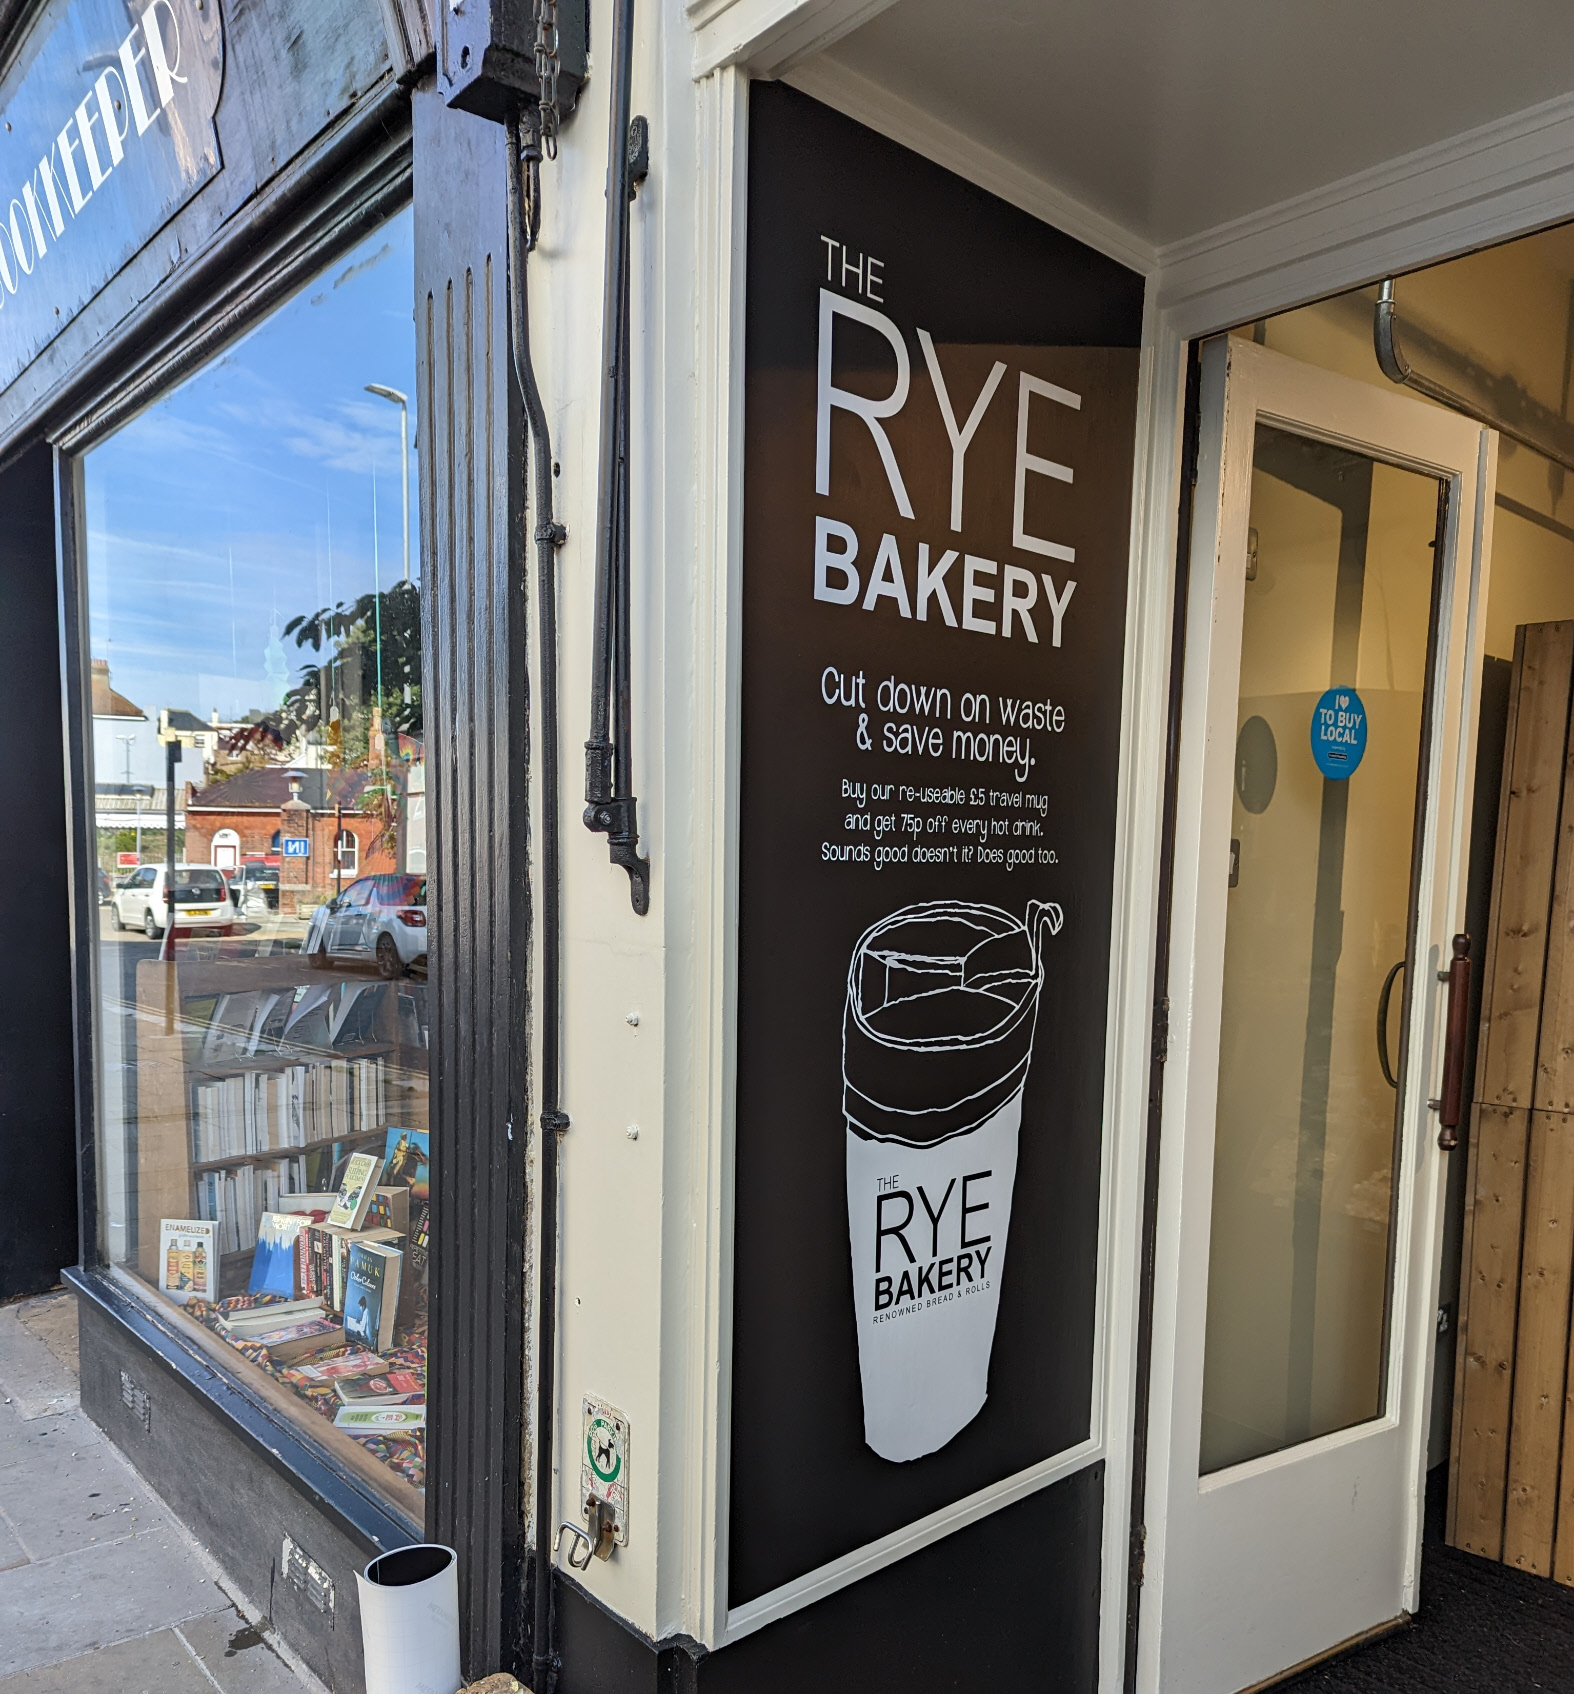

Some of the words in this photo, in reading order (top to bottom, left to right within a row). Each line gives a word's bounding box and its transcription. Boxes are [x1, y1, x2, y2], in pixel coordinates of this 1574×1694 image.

[0, 0, 188, 309] OOKKEEPER
[820, 234, 885, 304] THE
[815, 287, 1082, 564] RYE
[813, 515, 1078, 649] BAKERY
[821, 666, 866, 709] Cut
[877, 675, 951, 720] down
[960, 692, 990, 724] on
[998, 697, 1066, 733] waste
[1319, 708, 1335, 725] TO
[1337, 711, 1363, 729] BUY
[1335, 694, 1340, 710] I
[856, 713, 872, 750] &
[882, 722, 944, 757] save
[952, 730, 1036, 783] money.
[1320, 725, 1358, 745] LOCAL
[841, 778, 867, 808] Buy
[871, 784, 895, 801] our
[899, 785, 966, 805] re-useable
[969, 788, 986, 805] £5
[989, 788, 1022, 808] travel
[1025, 792, 1048, 817] mug
[844, 812, 871, 832] and
[874, 813, 896, 839] get
[900, 814, 922, 840] 75p
[926, 815, 949, 833] off
[952, 818, 988, 843] every
[991, 818, 1009, 836] hot
[1012, 818, 1044, 837] drink.
[821, 841, 871, 862] Sounds
[874, 844, 908, 870] good
[912, 845, 958, 863] doesn't
[961, 846, 974, 863] it?
[977, 846, 1004, 864] Does
[1006, 847, 1035, 872] good
[1038, 847, 1059, 864] too.
[876, 1174, 900, 1193] THE
[875, 1169, 993, 1274] RYE
[872, 1302, 923, 1324] RENOWNED
[926, 1292, 954, 1308] BREAD
[957, 1290, 962, 1299] &
[965, 1281, 991, 1296] ROLLS
[874, 1245, 993, 1312] BAKERY
